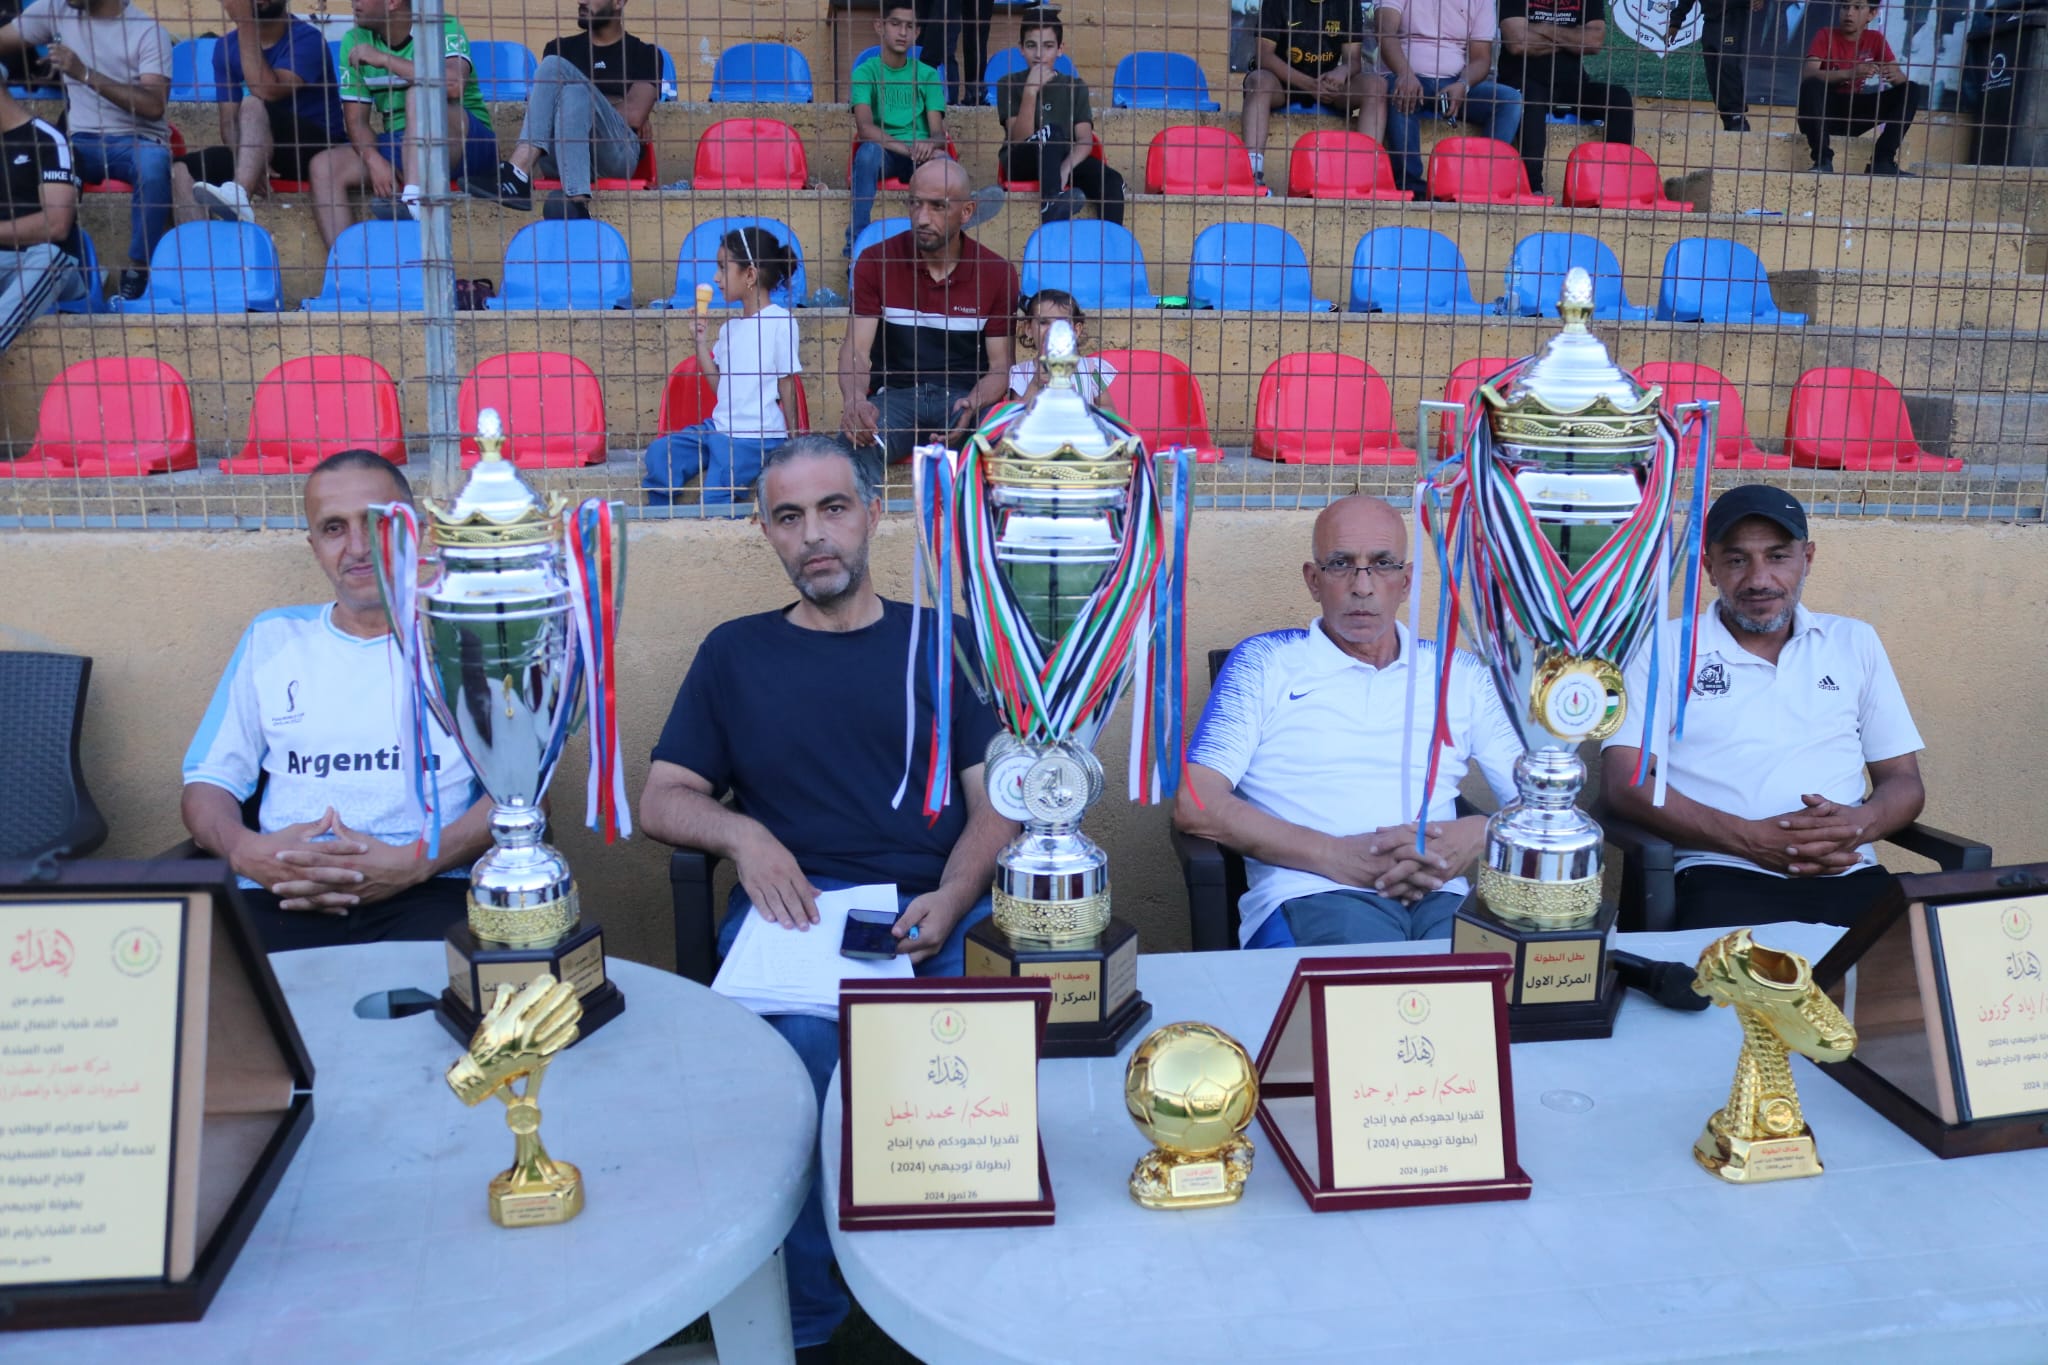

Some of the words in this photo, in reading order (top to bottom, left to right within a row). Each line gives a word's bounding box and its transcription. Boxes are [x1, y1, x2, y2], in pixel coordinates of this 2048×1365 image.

[44, 171, 68, 180] NIKE
[1533, 952, 1566, 965] البطولة
[1567, 953, 1585, 963] بطل
[1525, 975, 1553, 989] الاول
[1555, 973, 1592, 989] المركز
[1060, 990, 1096, 1006] المركز
[1389, 1115, 1407, 1124] في
[1409, 1112, 1455, 1125] لجهودكم
[1457, 1110, 1485, 1124] تقديرا
[916, 1139, 935, 1148] في
[938, 1136, 987, 1148] لجهودكم
[989, 1135, 1019, 1148] تقديرا
[1402, 1136, 1442, 1149] توجيهي
[928, 1161, 973, 1173] توجيهي
[1400, 1167, 1418, 1175] 2024
[1421, 1166, 1438, 1177] تموز
[924, 1192, 944, 1200] 2024
[947, 1191, 966, 1202] تموز
